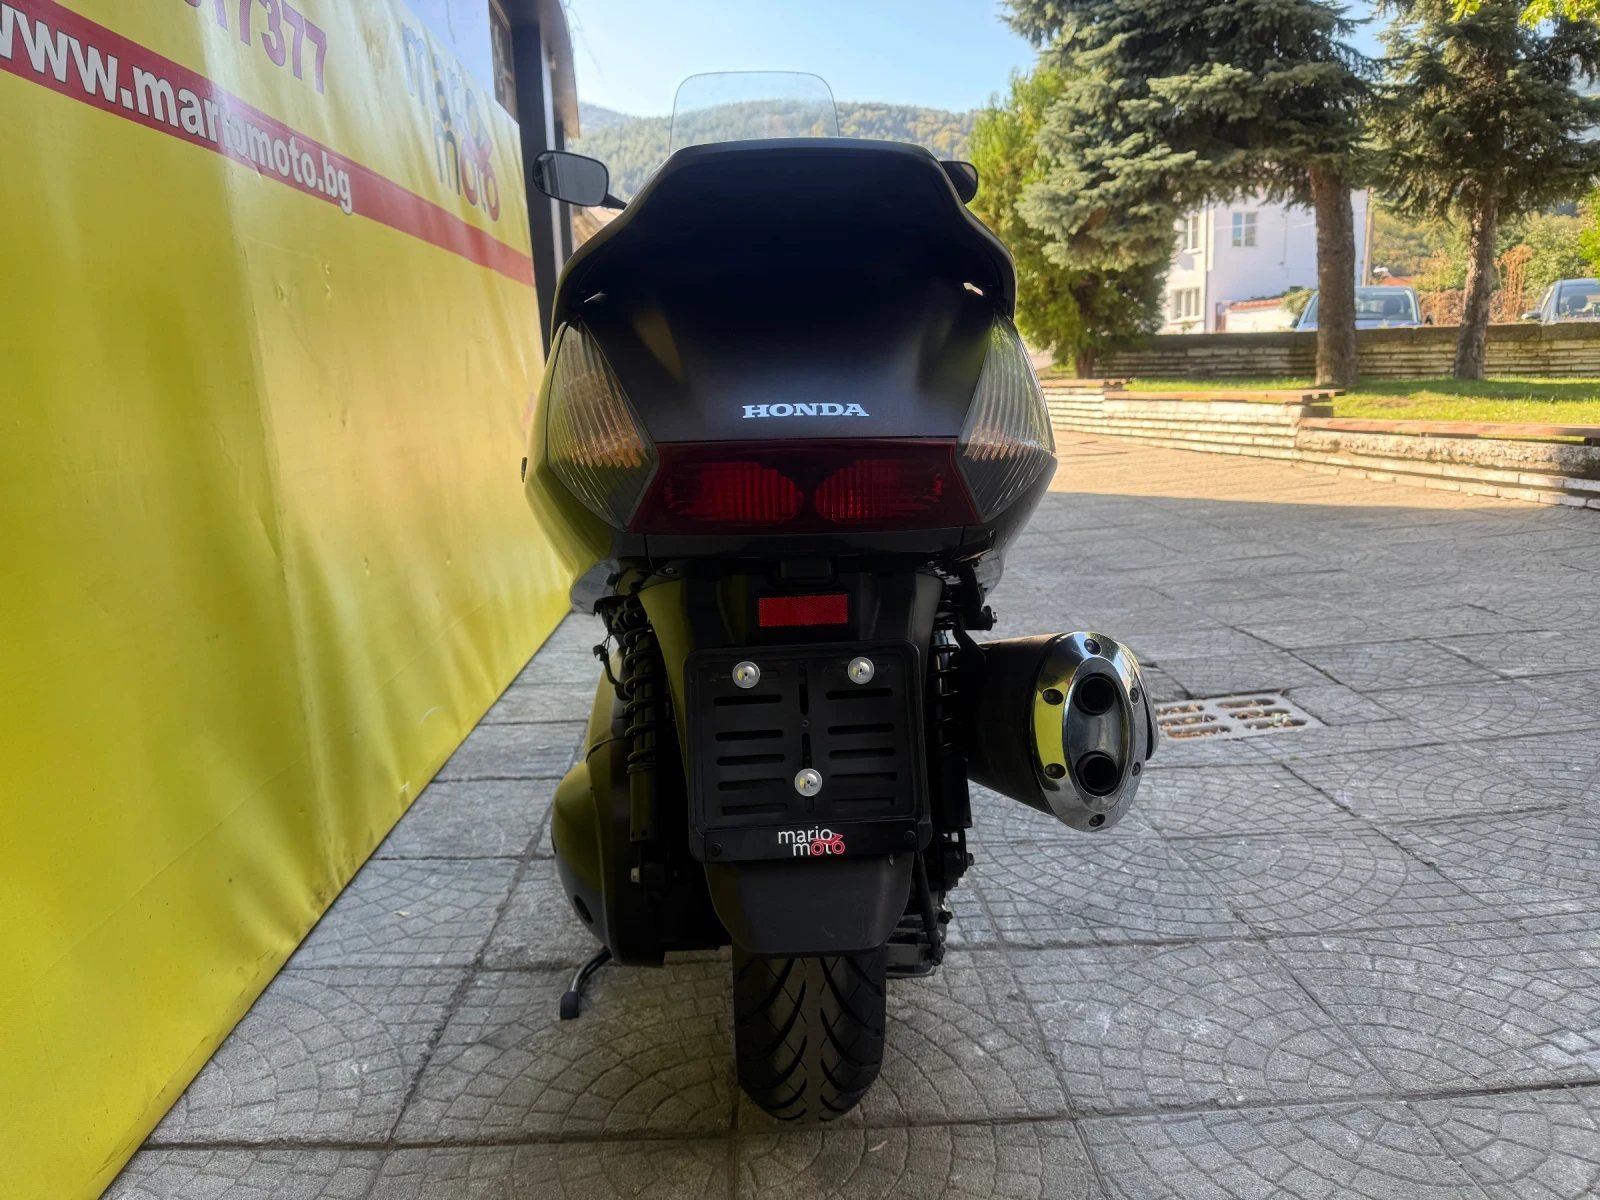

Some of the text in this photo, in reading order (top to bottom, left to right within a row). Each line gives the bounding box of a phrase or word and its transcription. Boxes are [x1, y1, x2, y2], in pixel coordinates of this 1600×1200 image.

[0, 1, 352, 216] ww.mariomoto.bg
[433, 120, 499, 222] moto
[742, 403, 870, 419] HONDA
[777, 825, 833, 844] mario
[792, 841, 846, 857] moto
